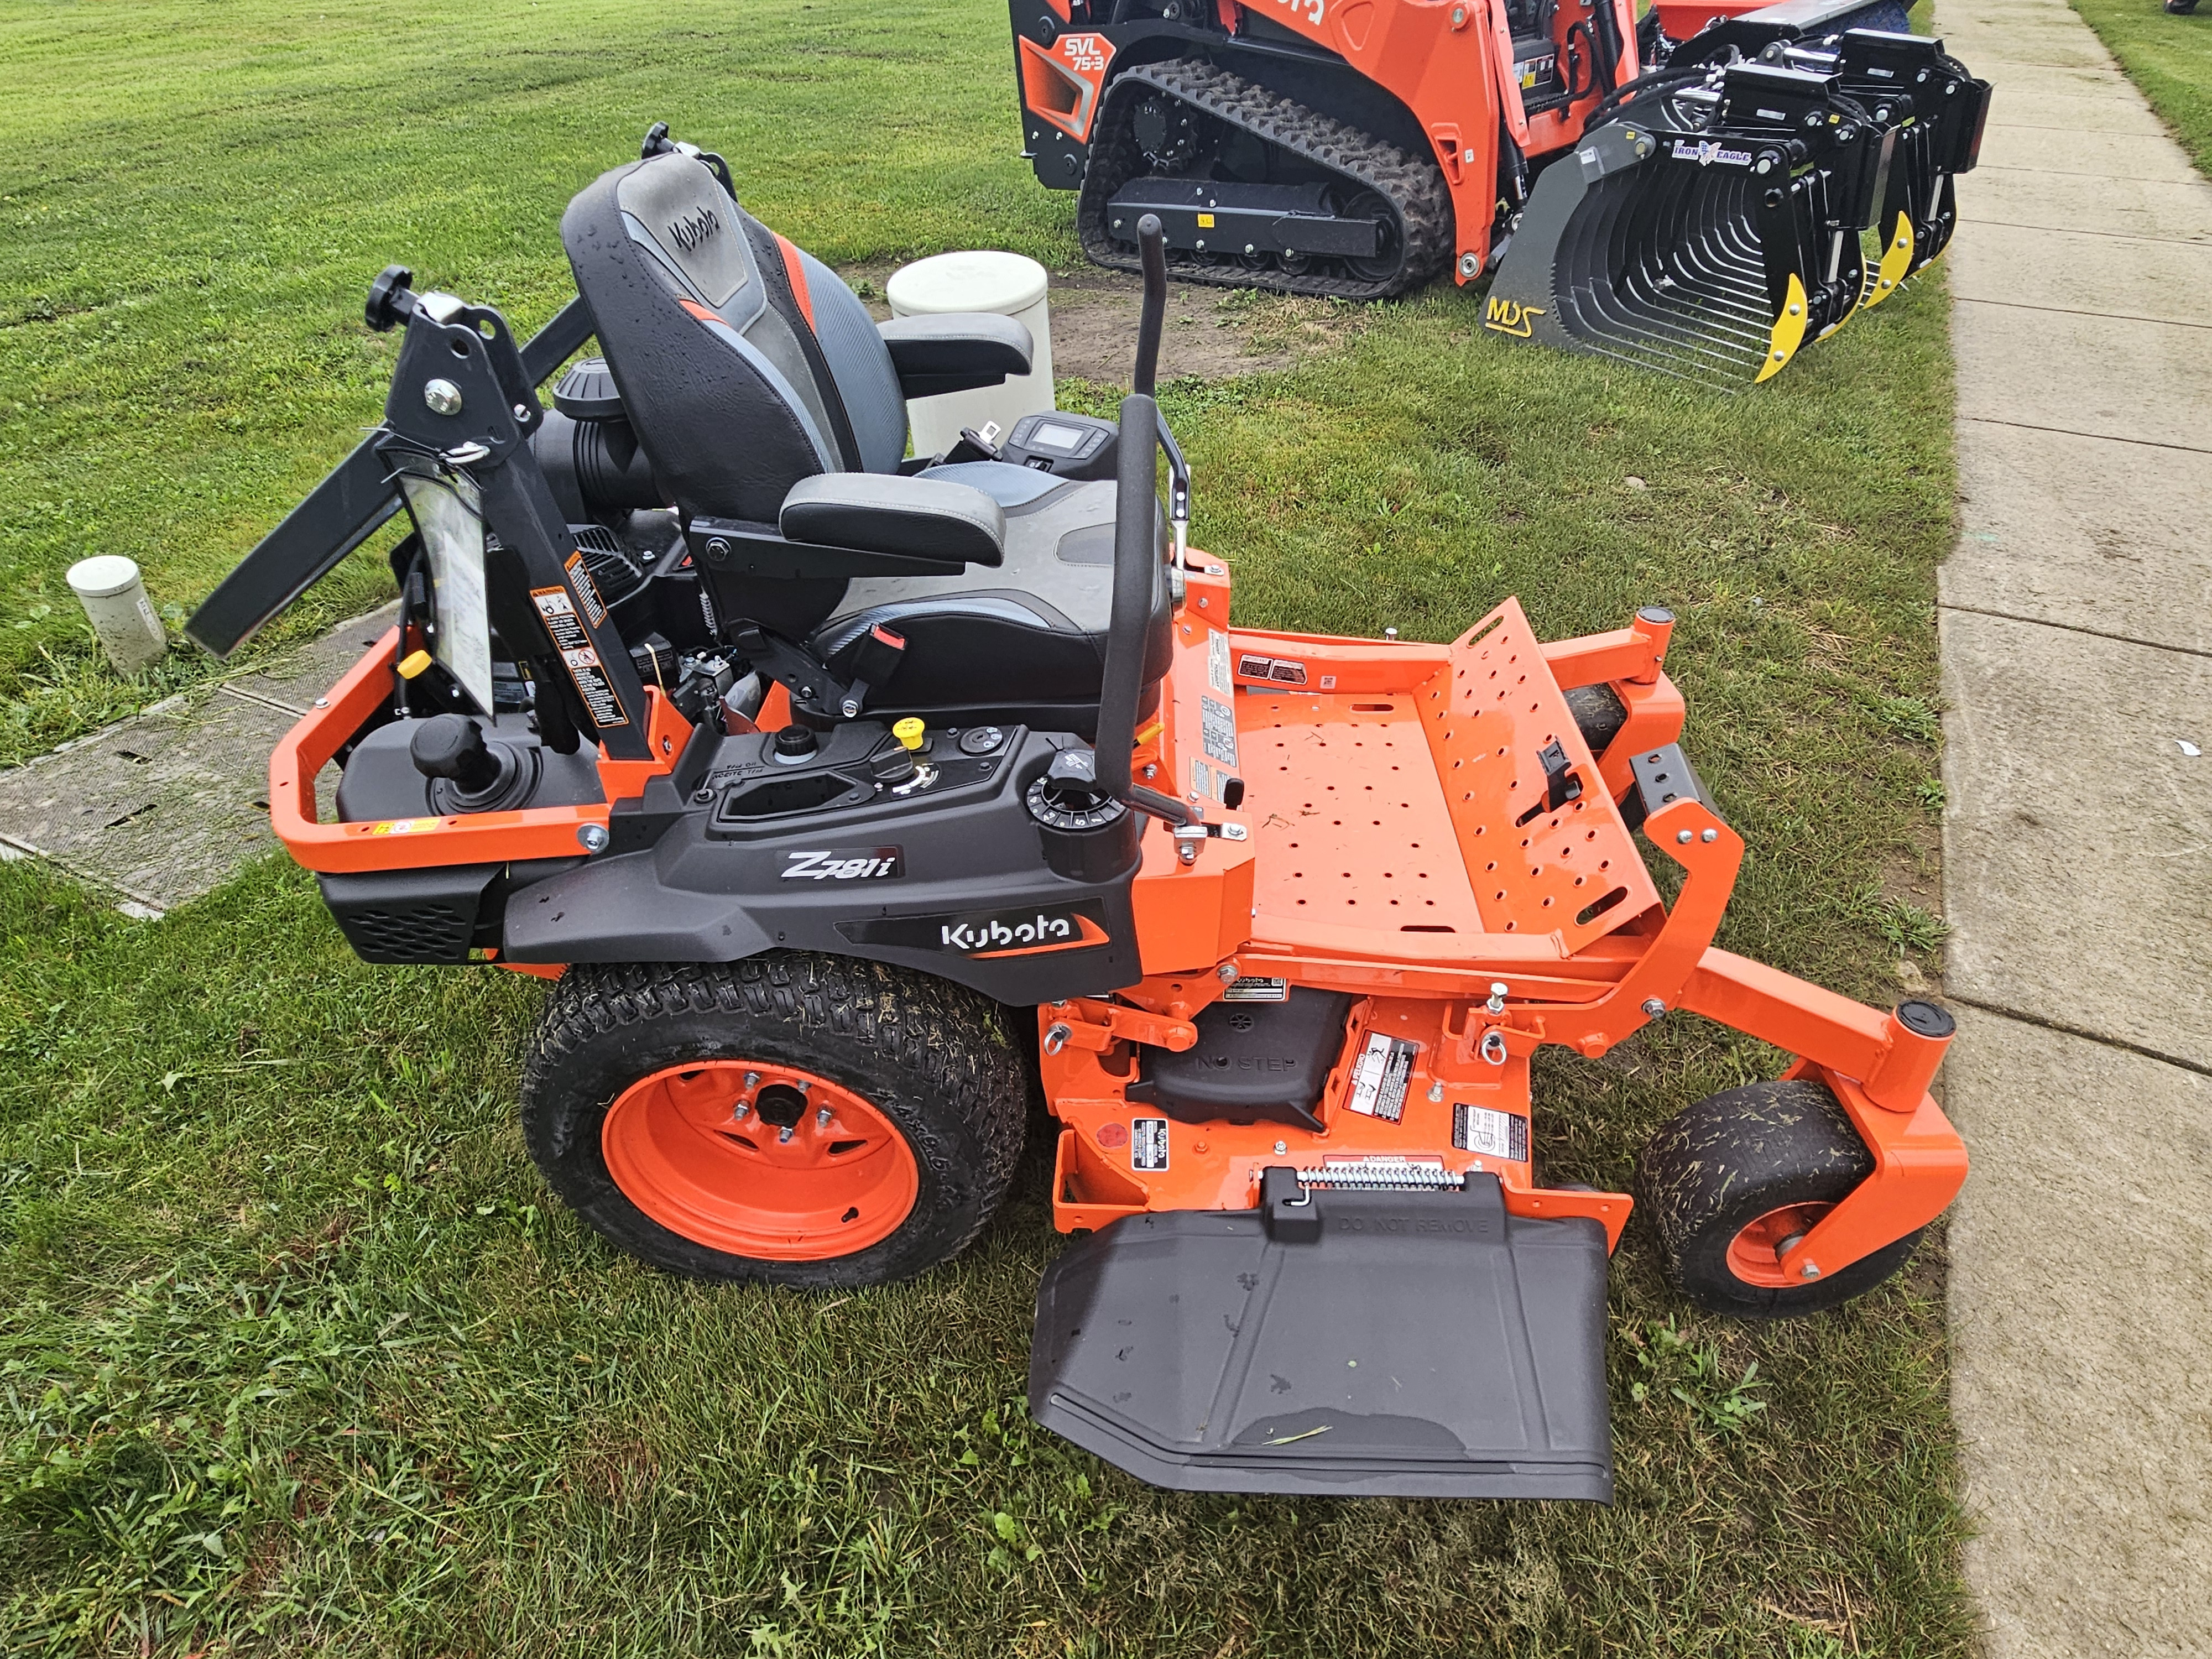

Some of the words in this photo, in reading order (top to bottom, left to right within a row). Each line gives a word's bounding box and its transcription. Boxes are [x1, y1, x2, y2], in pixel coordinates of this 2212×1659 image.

[1065, 38, 1100, 56] SVL
[1072, 56, 1104, 71] 75-3
[1674, 147, 1698, 156] IRON
[1716, 151, 1750, 161] EAGLE
[667, 206, 720, 252] Kubota
[781, 851, 895, 879] Z781i
[941, 915, 1070, 949] Kubota
[1196, 1056, 1231, 1071] NO
[1238, 1056, 1297, 1071] STEP
[1352, 1053, 1365, 1079] PELIGRO
[1157, 1128, 1167, 1159] Kubota
[1339, 1218, 1364, 1231] DO
[1374, 1218, 1410, 1232] NOT
[1415, 1218, 1489, 1233] REMOVE
